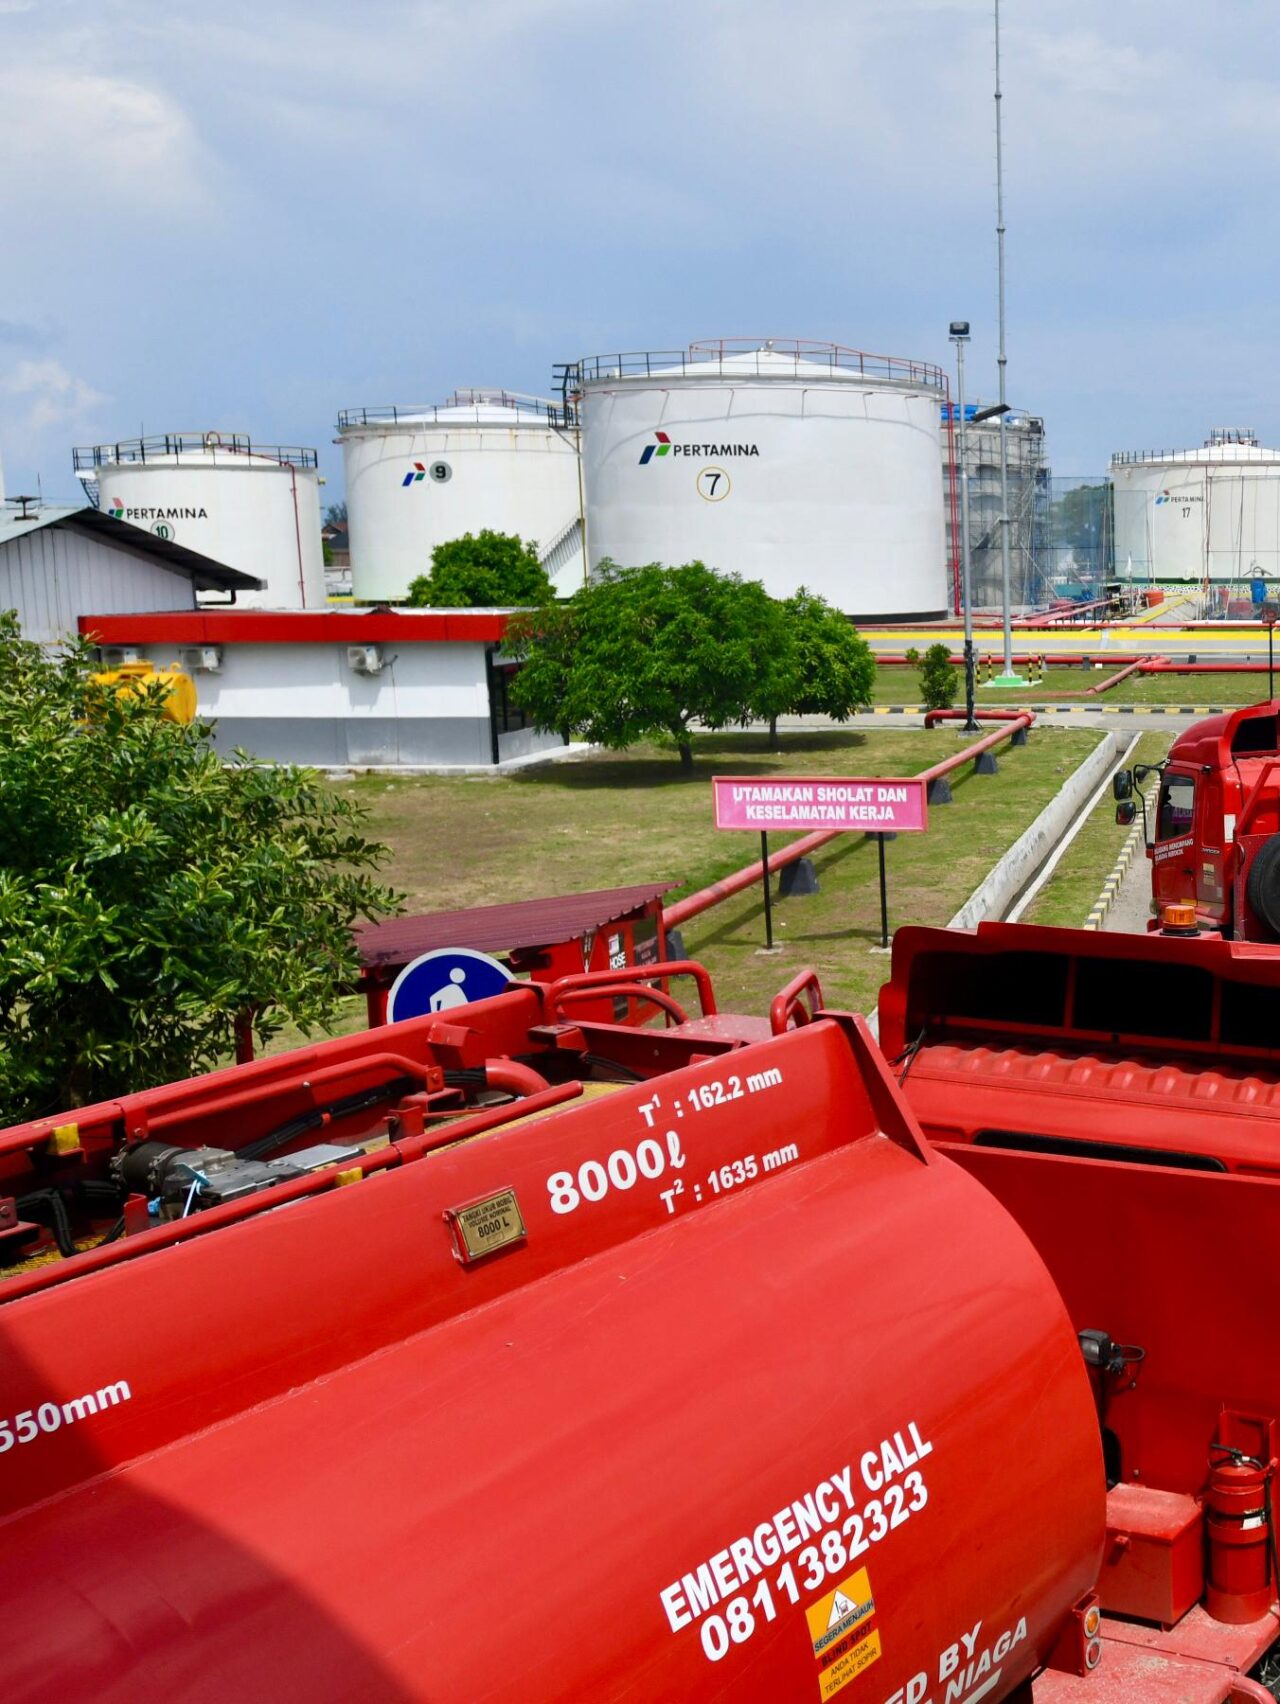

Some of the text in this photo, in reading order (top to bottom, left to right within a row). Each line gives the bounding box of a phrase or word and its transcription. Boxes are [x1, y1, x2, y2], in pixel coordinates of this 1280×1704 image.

[674, 444, 760, 457] PERTAMINA
[435, 465, 446, 479] 9
[705, 473, 721, 496] 7
[126, 508, 208, 519] PERTAMINA
[1182, 507, 1191, 518] 17
[155, 525, 169, 540] 10
[732, 787, 907, 803] UTAMAKAN SHOLAT DAN
[746, 805, 894, 820] KESELAMATAN KERJA
[688, 1075, 745, 1112] 162.2
[746, 1067, 784, 1093] mm
[707, 1154, 759, 1194] 1635
[762, 1142, 800, 1172] mm
[477, 1216, 510, 1238] 8000 L
[659, 1421, 933, 1634] EMERGENCY CALL
[700, 1471, 928, 1662] 0811382323
[814, 1598, 875, 1653] SEGERA MENJAUH
[821, 1621, 872, 1668] BLIND SPOT
[830, 1641, 869, 1678] ANDA TIDAK
[939, 1620, 983, 1684] BY
[945, 1616, 1027, 1704] NIAGA
[824, 1664, 856, 1694] TERLIHAT
